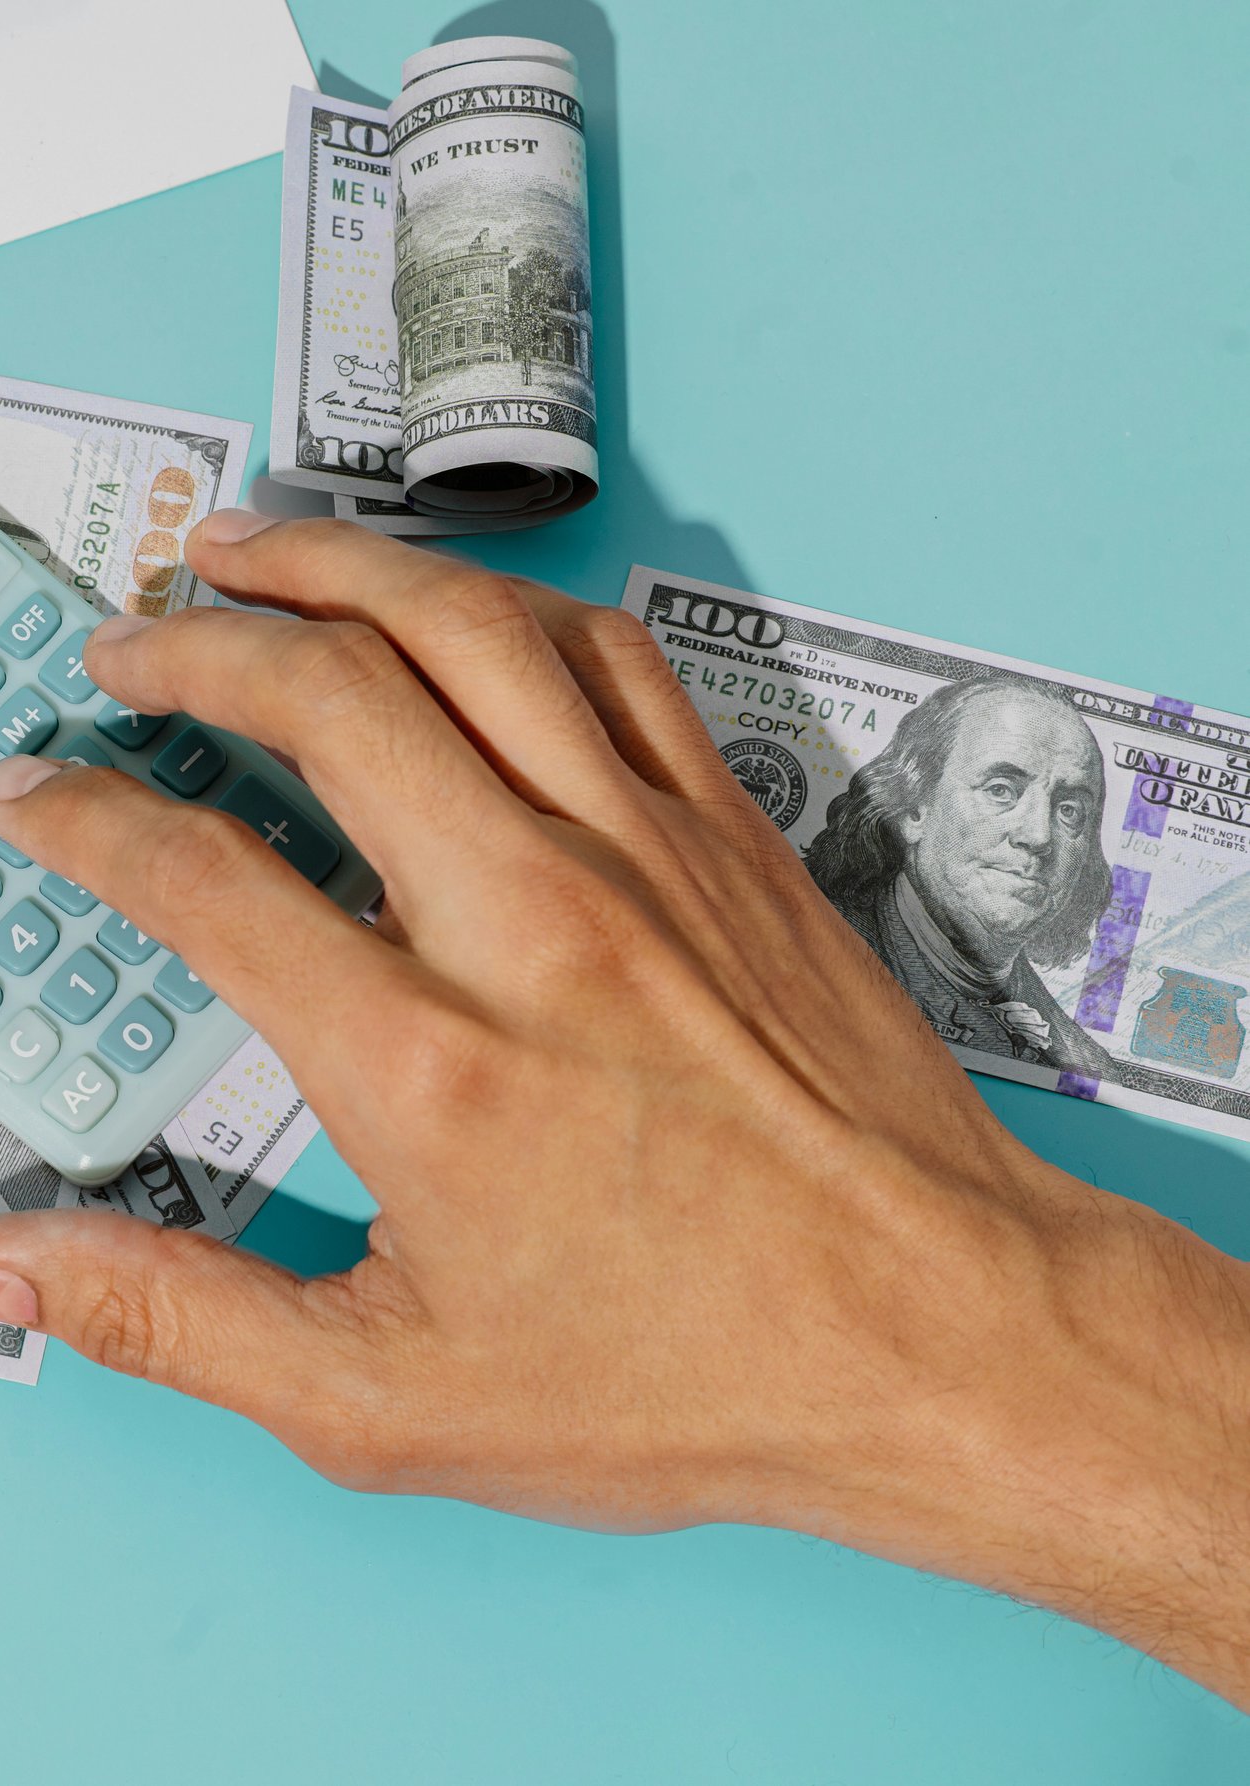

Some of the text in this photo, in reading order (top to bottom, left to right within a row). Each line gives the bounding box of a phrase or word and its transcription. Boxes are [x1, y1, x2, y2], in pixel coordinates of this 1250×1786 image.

[333, 155, 392, 177] FEDER
[410, 138, 539, 176] WE TRUST
[332, 215, 364, 242] E5
[348, 378, 381, 397] Secretary
[326, 410, 360, 425] Treasurer
[423, 403, 551, 438] DOLLARS
[70, 500, 116, 594] 03207
[11, 604, 47, 641] OFF
[656, 592, 787, 654] 100
[663, 630, 919, 708] FEDERAL RESERVE NOTE
[1073, 692, 1133, 719] ONE
[1, 707, 41, 745] M+
[735, 708, 807, 742] COPY
[720, 732, 804, 779] UNITED STATES
[1166, 825, 1208, 843] FOR ALL
[1192, 823, 1246, 844] THIS NOTE
[11, 923, 39, 954] 4
[69, 973, 97, 996] 1
[10, 1030, 41, 1058] C
[61, 1071, 103, 1114] AC
[202, 1120, 244, 1157] E5
